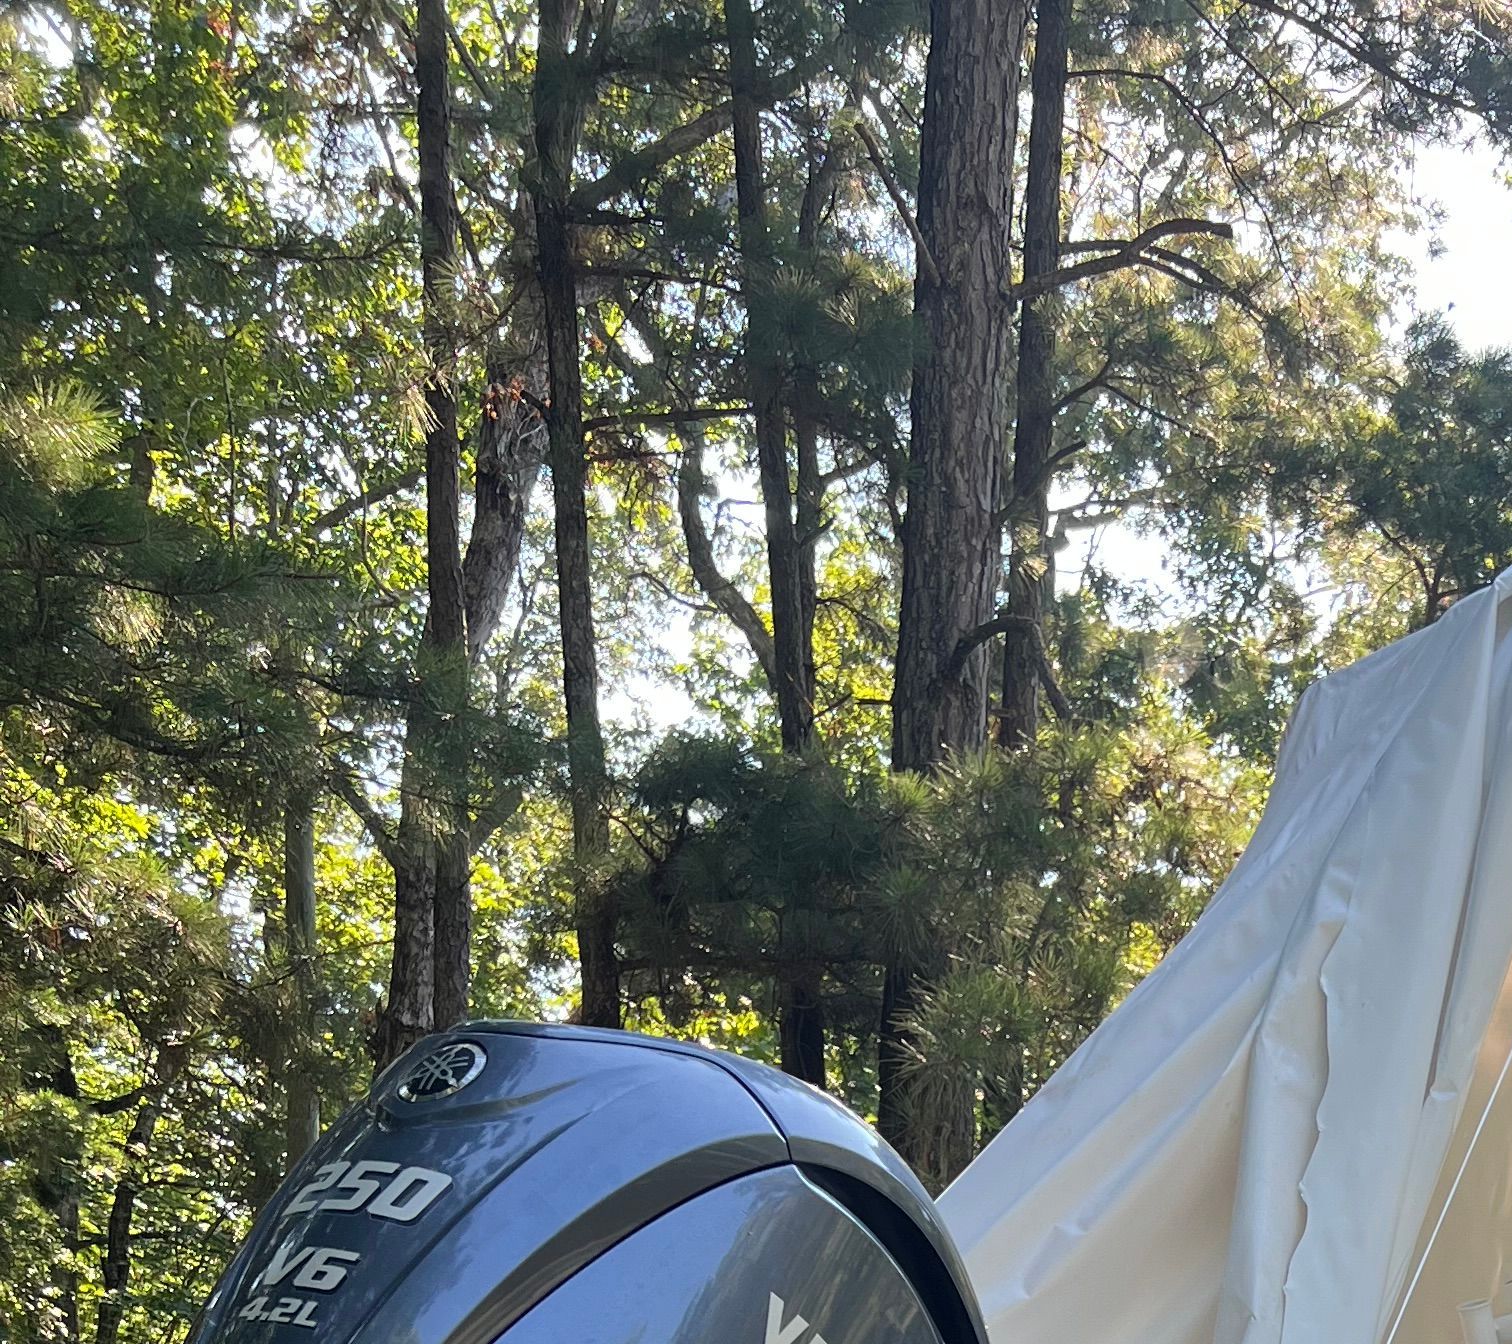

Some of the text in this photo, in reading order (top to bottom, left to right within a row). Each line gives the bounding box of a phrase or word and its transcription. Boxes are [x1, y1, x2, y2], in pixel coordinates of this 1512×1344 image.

[282, 1160, 454, 1224] 250
[262, 1247, 362, 1293] V6
[238, 1295, 319, 1328] 4.2L
